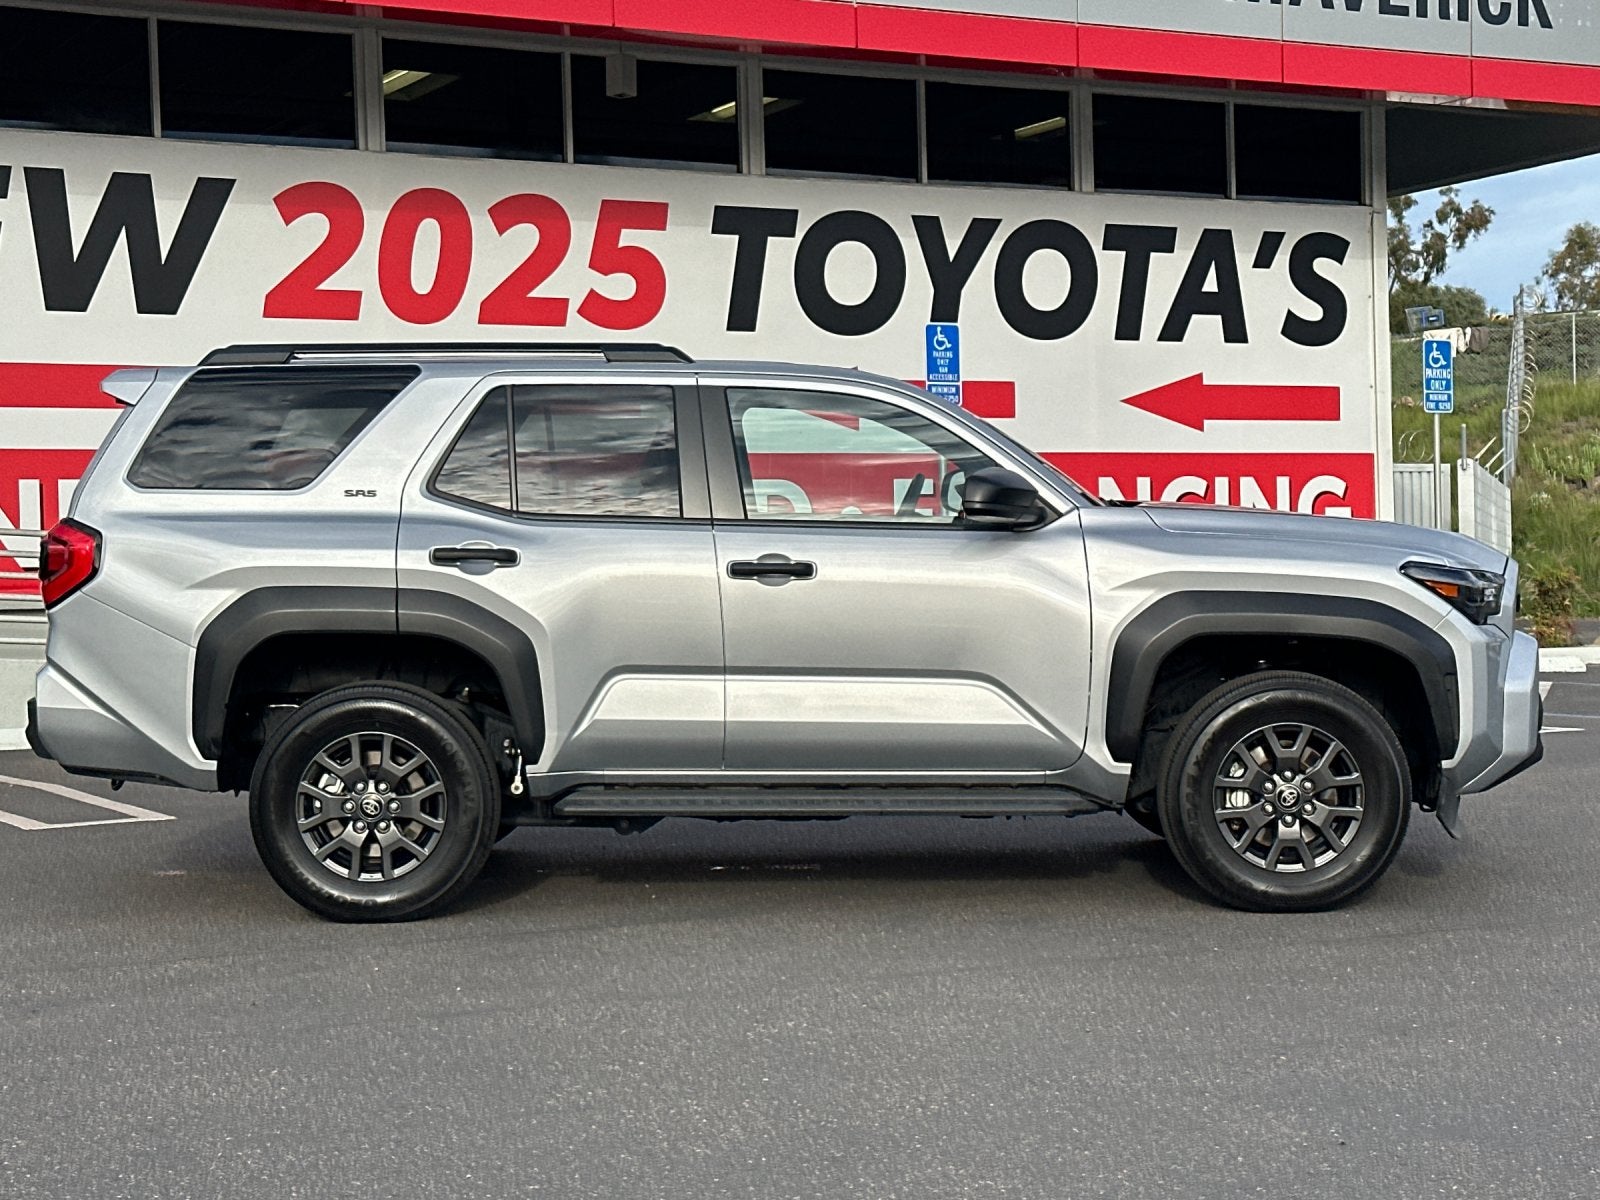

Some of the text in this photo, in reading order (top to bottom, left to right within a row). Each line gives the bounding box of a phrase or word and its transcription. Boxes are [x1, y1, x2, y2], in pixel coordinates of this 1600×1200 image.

[264, 181, 667, 329] 2025
[711, 205, 1350, 347] TOYOTA'S
[937, 358, 949, 366] ONLY
[929, 373, 958, 381] ACCESSIBLE
[1425, 368, 1451, 379] PARKING
[1430, 379, 1446, 391] ONLY
[1426, 402, 1436, 410] FINE
